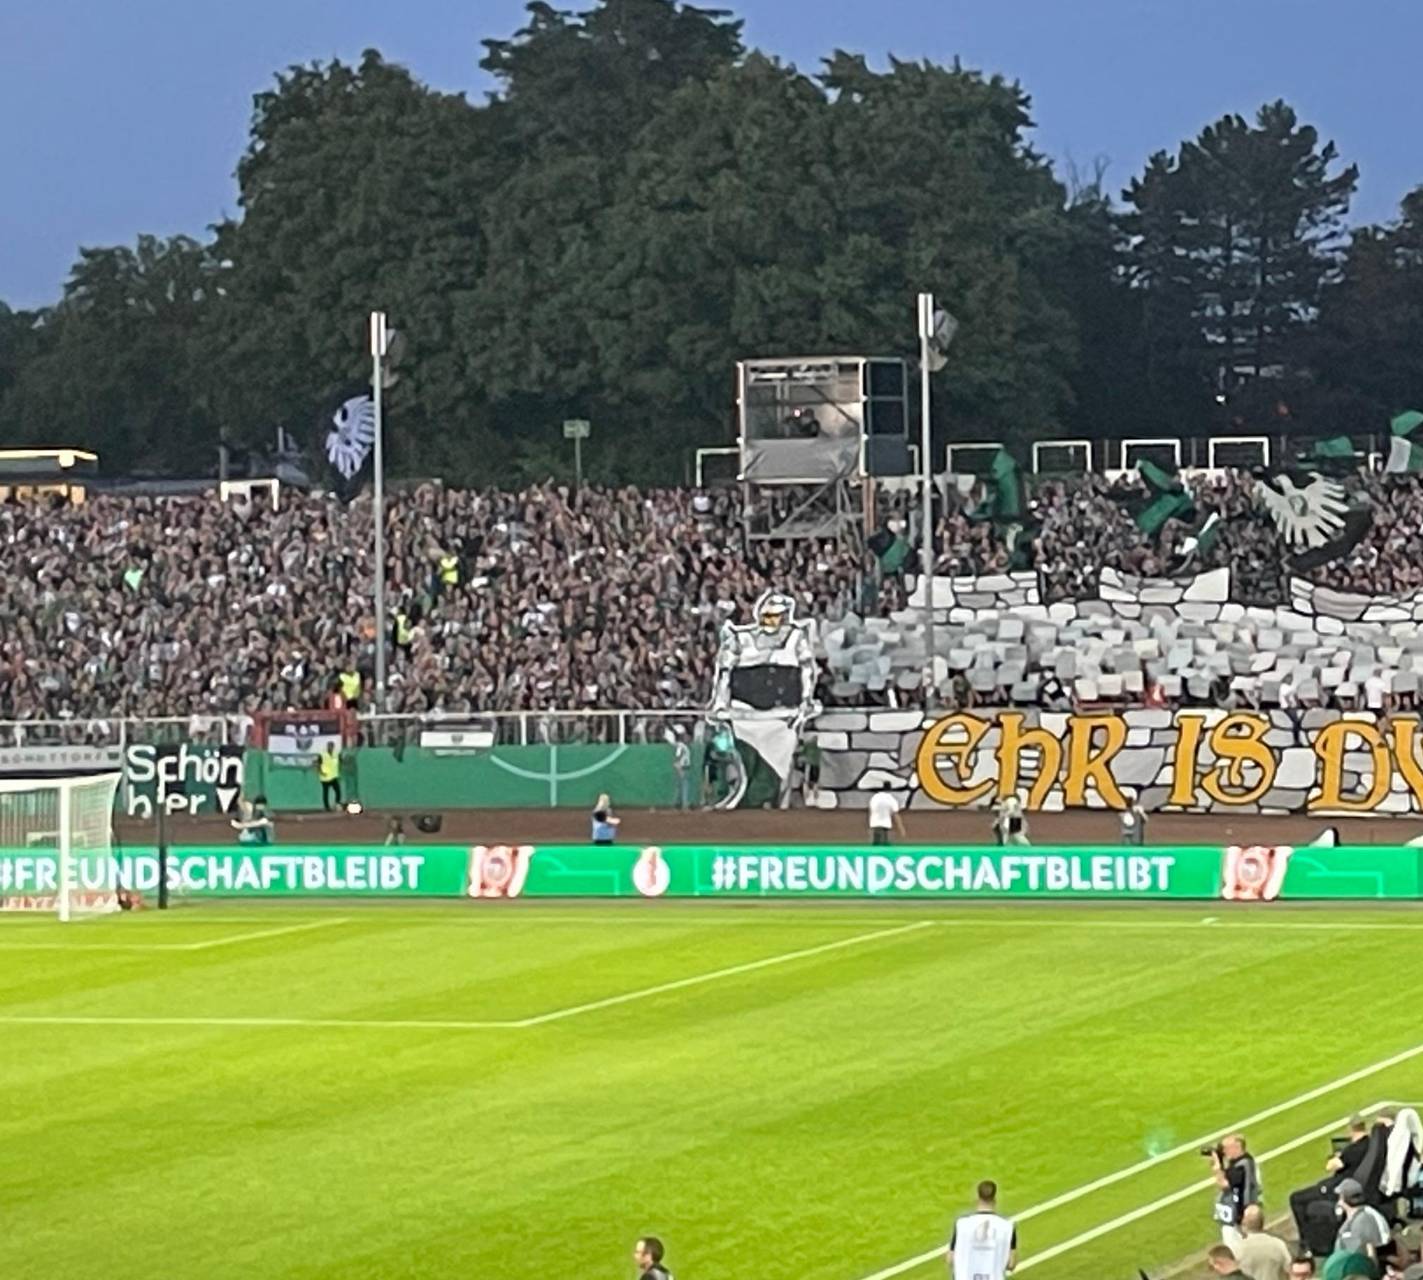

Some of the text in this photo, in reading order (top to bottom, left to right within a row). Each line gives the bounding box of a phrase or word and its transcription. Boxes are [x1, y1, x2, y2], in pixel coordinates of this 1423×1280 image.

[127, 743, 243, 784] Schön
[1171, 713, 1277, 810] IS
[711, 855, 1176, 892] #FREUNDSCHAFTBLEIBT
